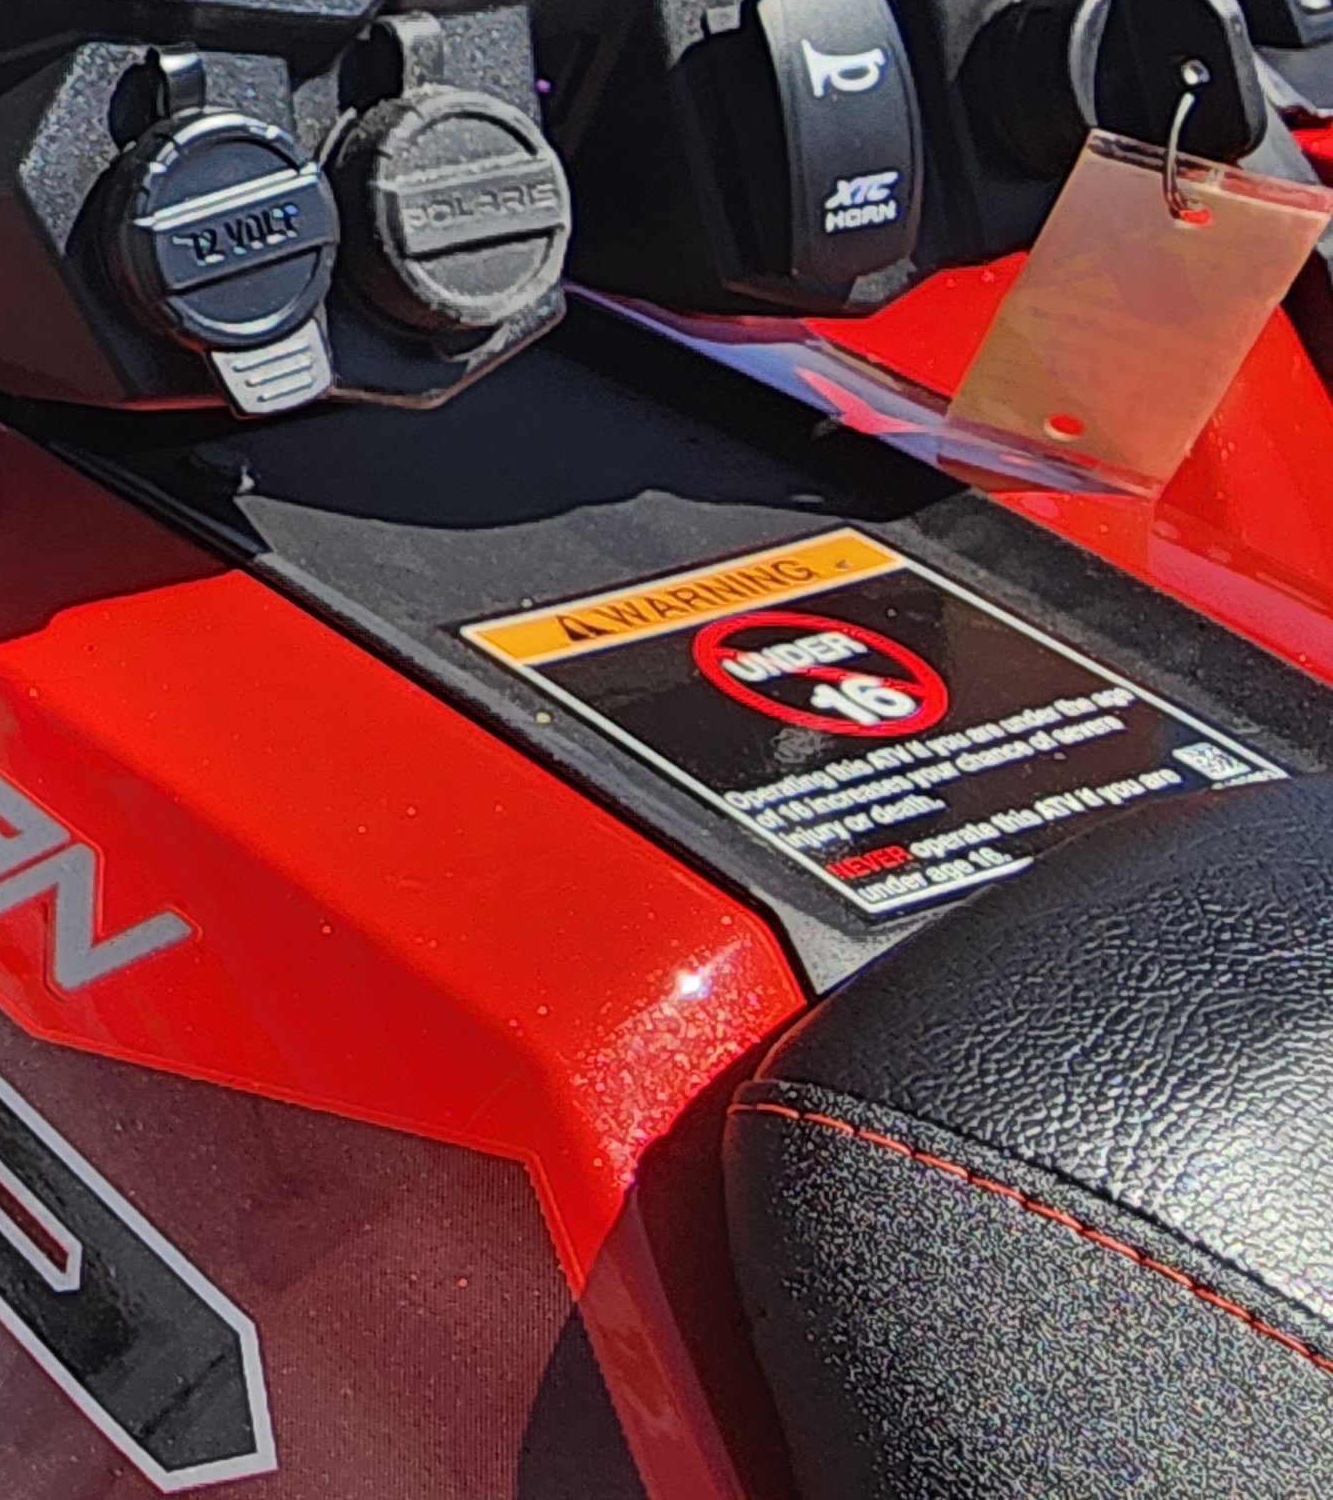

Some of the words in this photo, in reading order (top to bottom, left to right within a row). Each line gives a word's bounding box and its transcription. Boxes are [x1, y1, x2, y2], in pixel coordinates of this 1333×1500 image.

[406, 184, 559, 229] POLARIS
[824, 171, 899, 209] XTC
[824, 199, 897, 233] HORN
[599, 560, 817, 628] WARNING
[721, 630, 868, 683] UNDER
[810, 676, 918, 726] 16
[723, 770, 839, 811] Operating
[825, 758, 875, 782] this
[866, 744, 915, 771] ATV
[925, 731, 972, 758] you
[965, 722, 1007, 745] are
[999, 707, 1064, 735] under
[1053, 696, 1099, 718] the
[1090, 686, 1137, 708] age
[755, 807, 787, 830] of
[778, 799, 816, 821] 16
[803, 775, 916, 814] increases
[906, 760, 962, 789] your
[954, 739, 1035, 773] chance
[1028, 730, 1059, 752] of
[1051, 715, 1128, 746] severe
[778, 819, 852, 851] injury
[843, 811, 875, 832] or
[870, 793, 947, 825] death.
[826, 844, 914, 880] NEVER
[909, 821, 1003, 859] operate
[989, 808, 1045, 834] this
[1033, 790, 1086, 822] ATV
[1095, 778, 1146, 806] you
[1137, 768, 1183, 791] are
[856, 871, 929, 903] under
[925, 858, 976, 883] age
